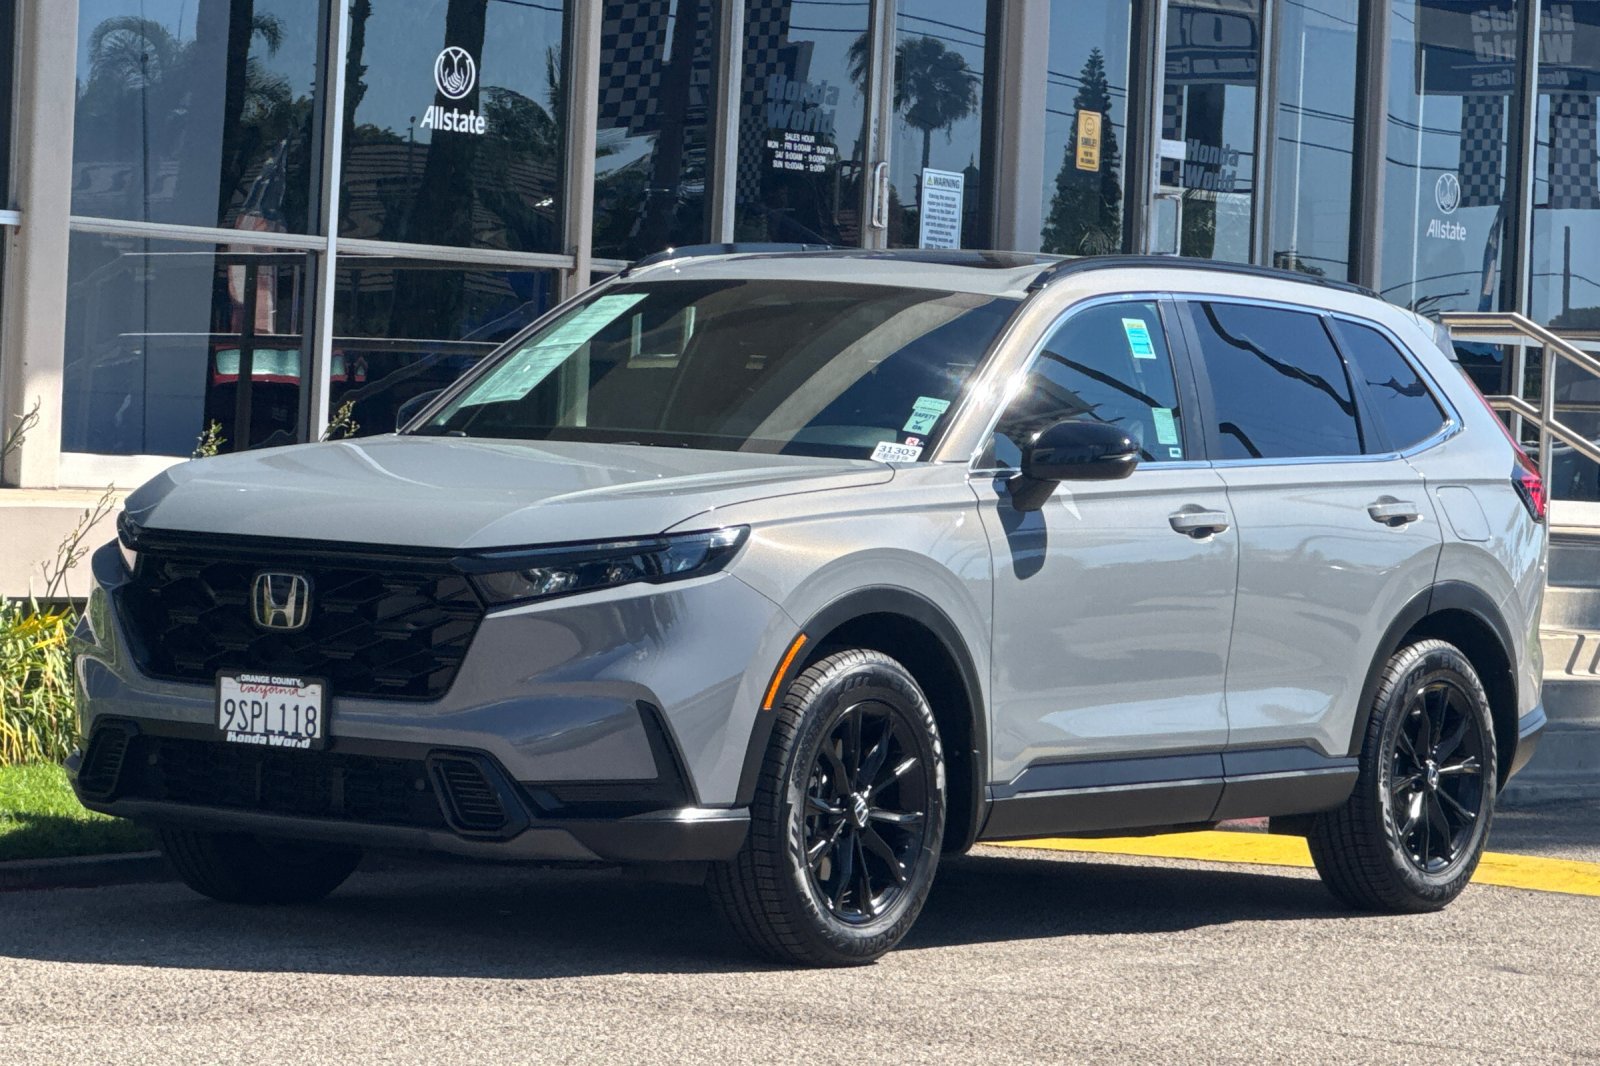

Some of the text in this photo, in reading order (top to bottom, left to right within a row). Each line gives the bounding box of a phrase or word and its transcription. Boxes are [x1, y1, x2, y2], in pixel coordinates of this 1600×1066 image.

[767, 74, 840, 106] Honda
[420, 105, 486, 134] Allstate
[767, 102, 836, 133] World
[767, 140, 779, 149] MON
[784, 142, 793, 151] FRI
[785, 132, 800, 142] SALES
[1185, 138, 1240, 167] Honda
[933, 175, 960, 189] WARNING
[1184, 163, 1238, 193] World
[1426, 219, 1467, 241] Allstate
[879, 445, 917, 457] 31303
[240, 674, 301, 686] ORANGE COUNTY
[240, 684, 299, 699] California
[223, 699, 318, 738] 9SPL118
[226, 731, 267, 746] Honda
